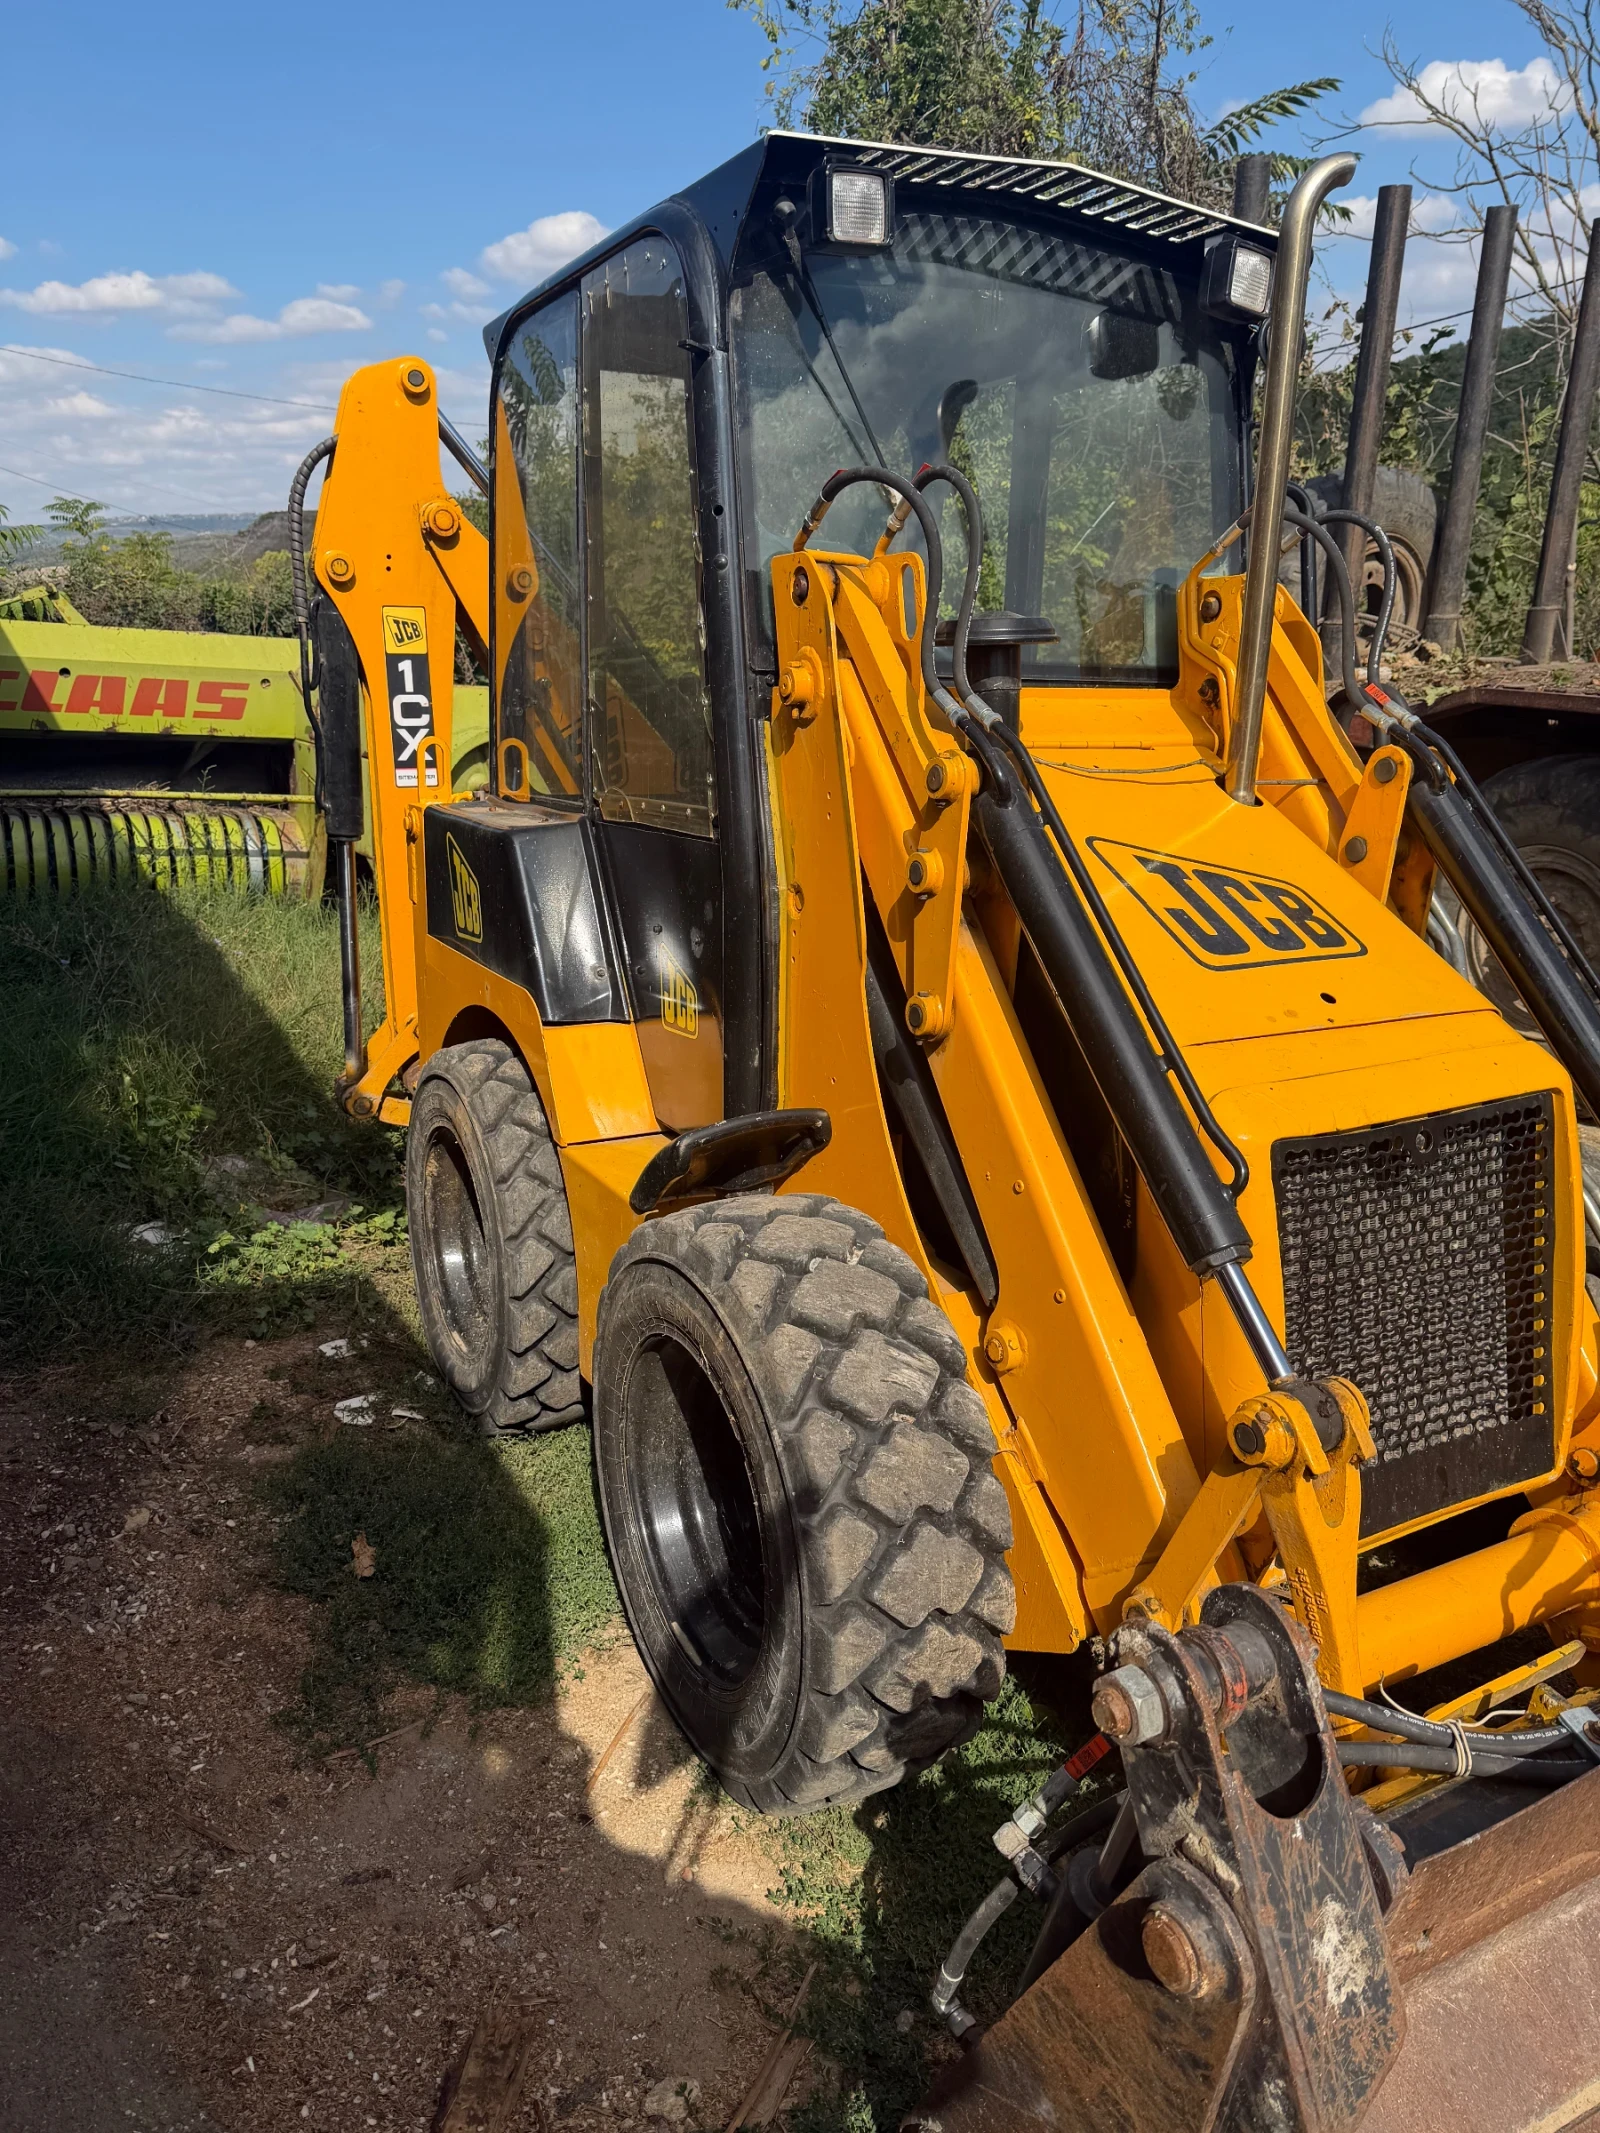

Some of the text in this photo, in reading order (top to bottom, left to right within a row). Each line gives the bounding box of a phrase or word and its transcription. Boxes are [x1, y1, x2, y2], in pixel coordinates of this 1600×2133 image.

[393, 619, 421, 644] JCB
[392, 659, 434, 761] 1CX
[453, 848, 481, 936] JCB
[1132, 854, 1347, 956] JCB
[663, 960, 697, 1033] JCB
